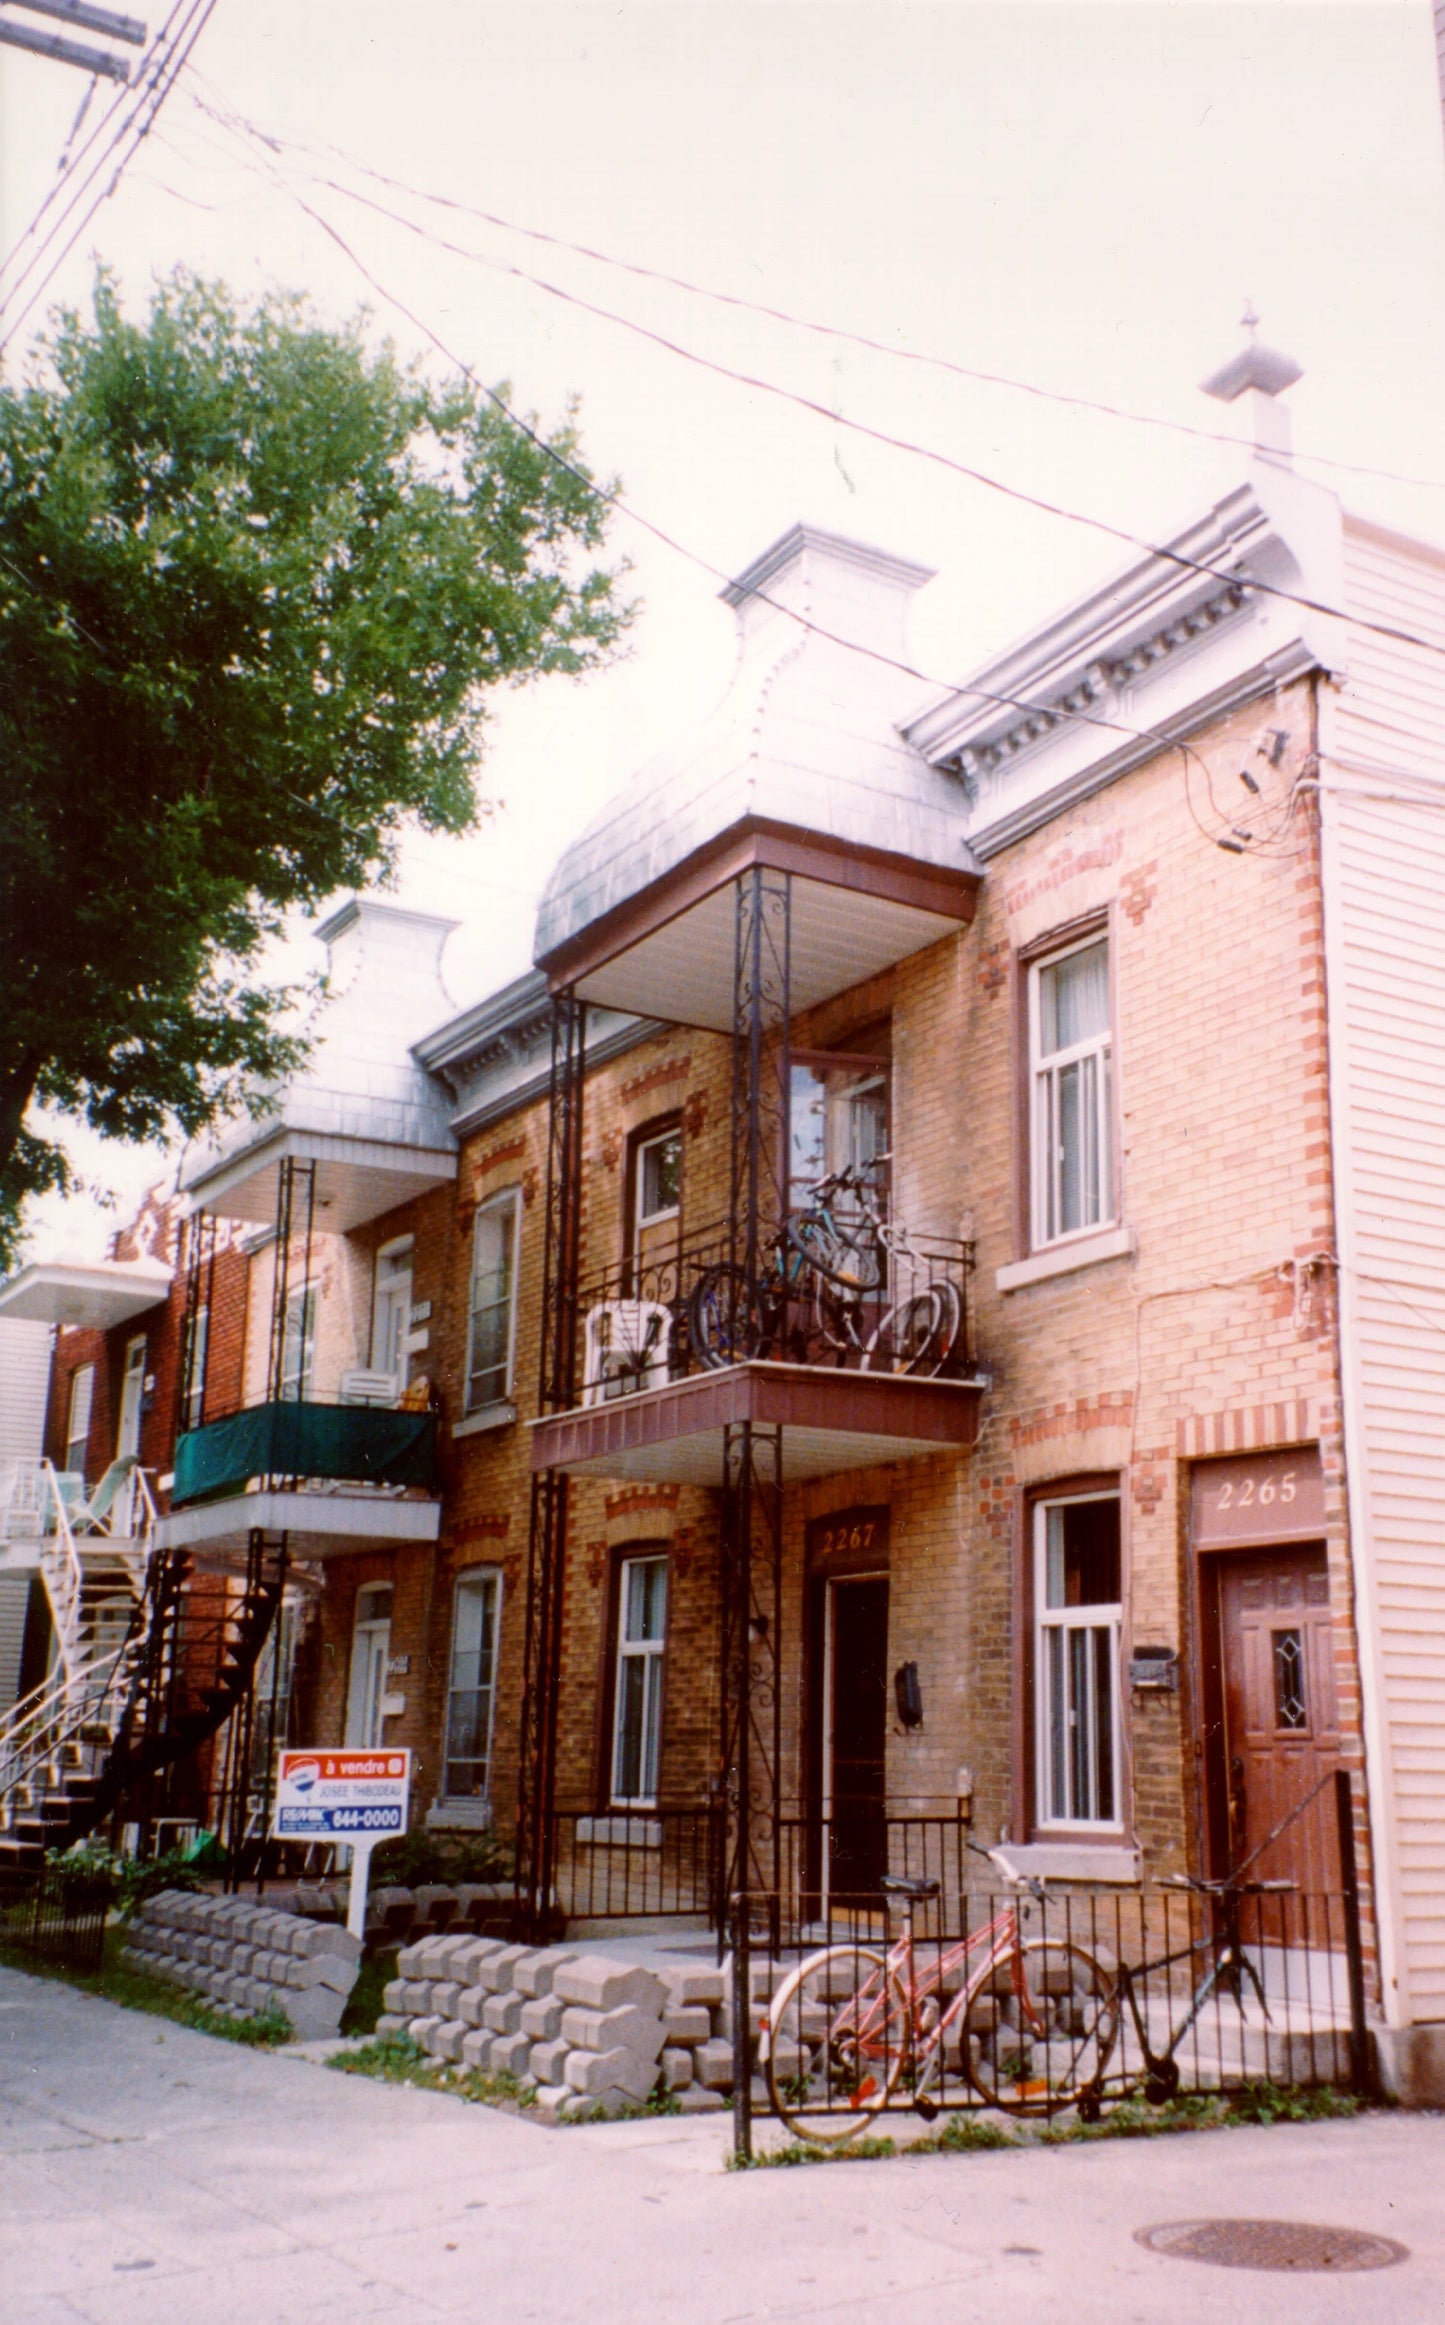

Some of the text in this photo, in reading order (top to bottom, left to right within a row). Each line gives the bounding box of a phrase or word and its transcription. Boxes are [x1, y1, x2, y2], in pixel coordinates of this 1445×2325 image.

[1217, 1471, 1296, 1510] 2265
[822, 1524, 875, 1554] 2267
[326, 1759, 386, 1775] à vendre
[353, 1784, 401, 1797] THIBODEAU
[332, 1808, 399, 1827] 644-0000
